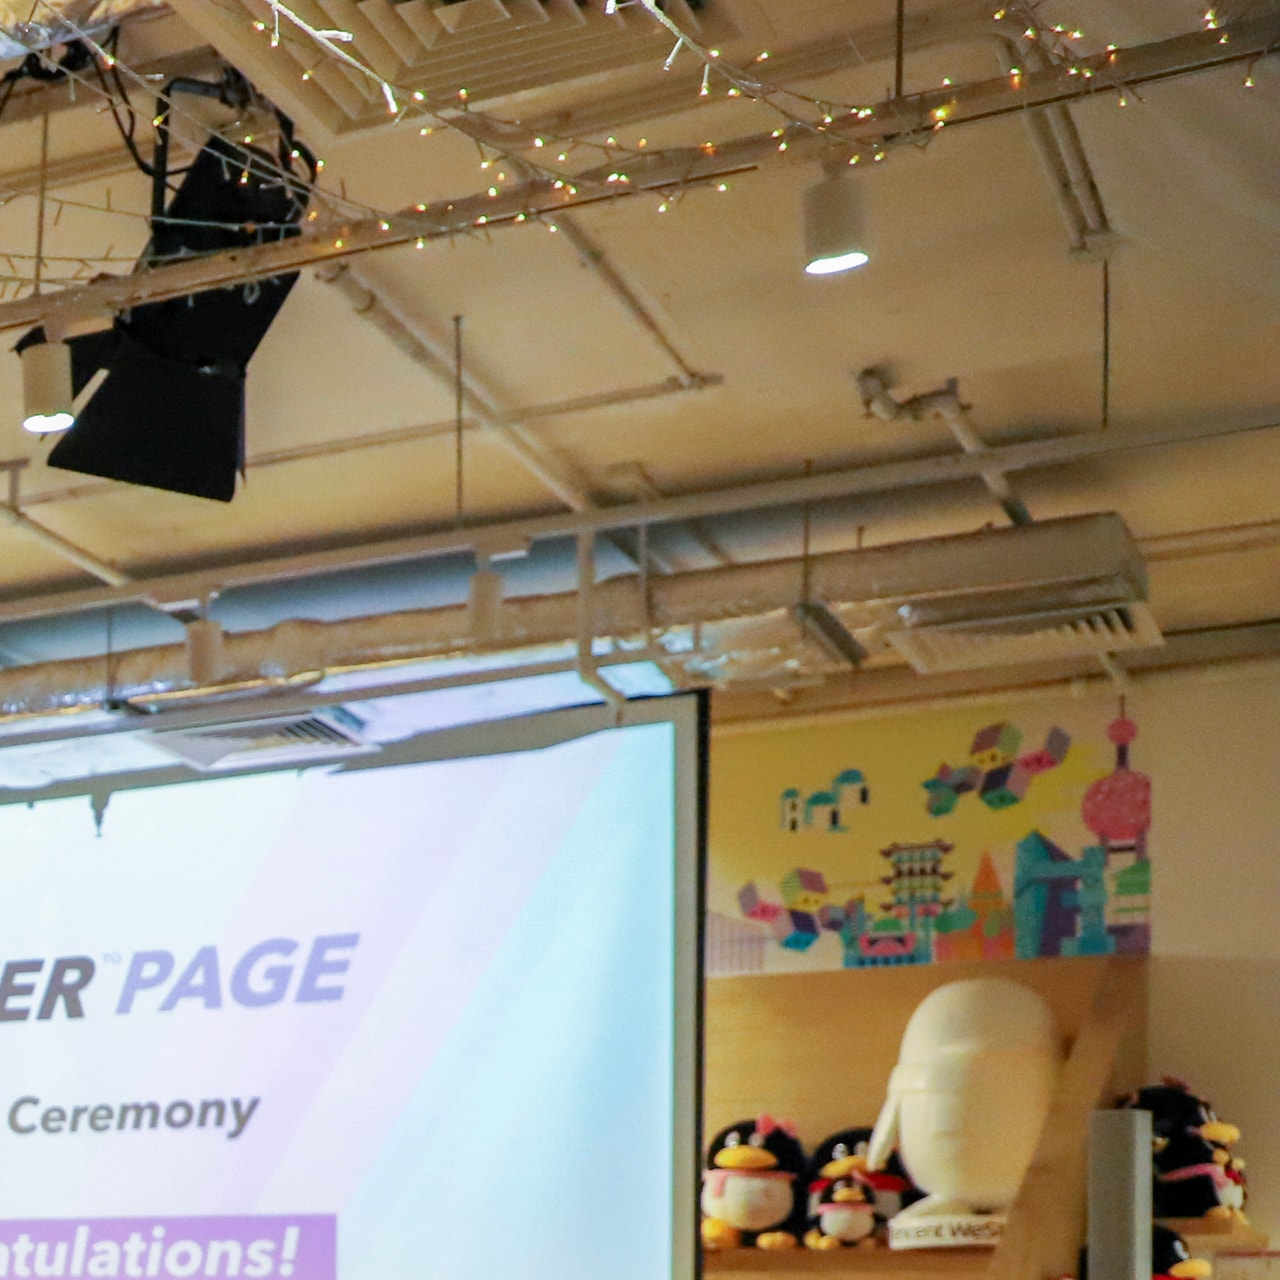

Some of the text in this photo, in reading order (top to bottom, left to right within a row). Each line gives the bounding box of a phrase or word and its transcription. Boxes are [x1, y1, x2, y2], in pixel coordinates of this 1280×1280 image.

[103, 951, 122, 965] TO
[114, 932, 361, 1016] PAGE
[7, 1096, 261, 1140] Ceremony
